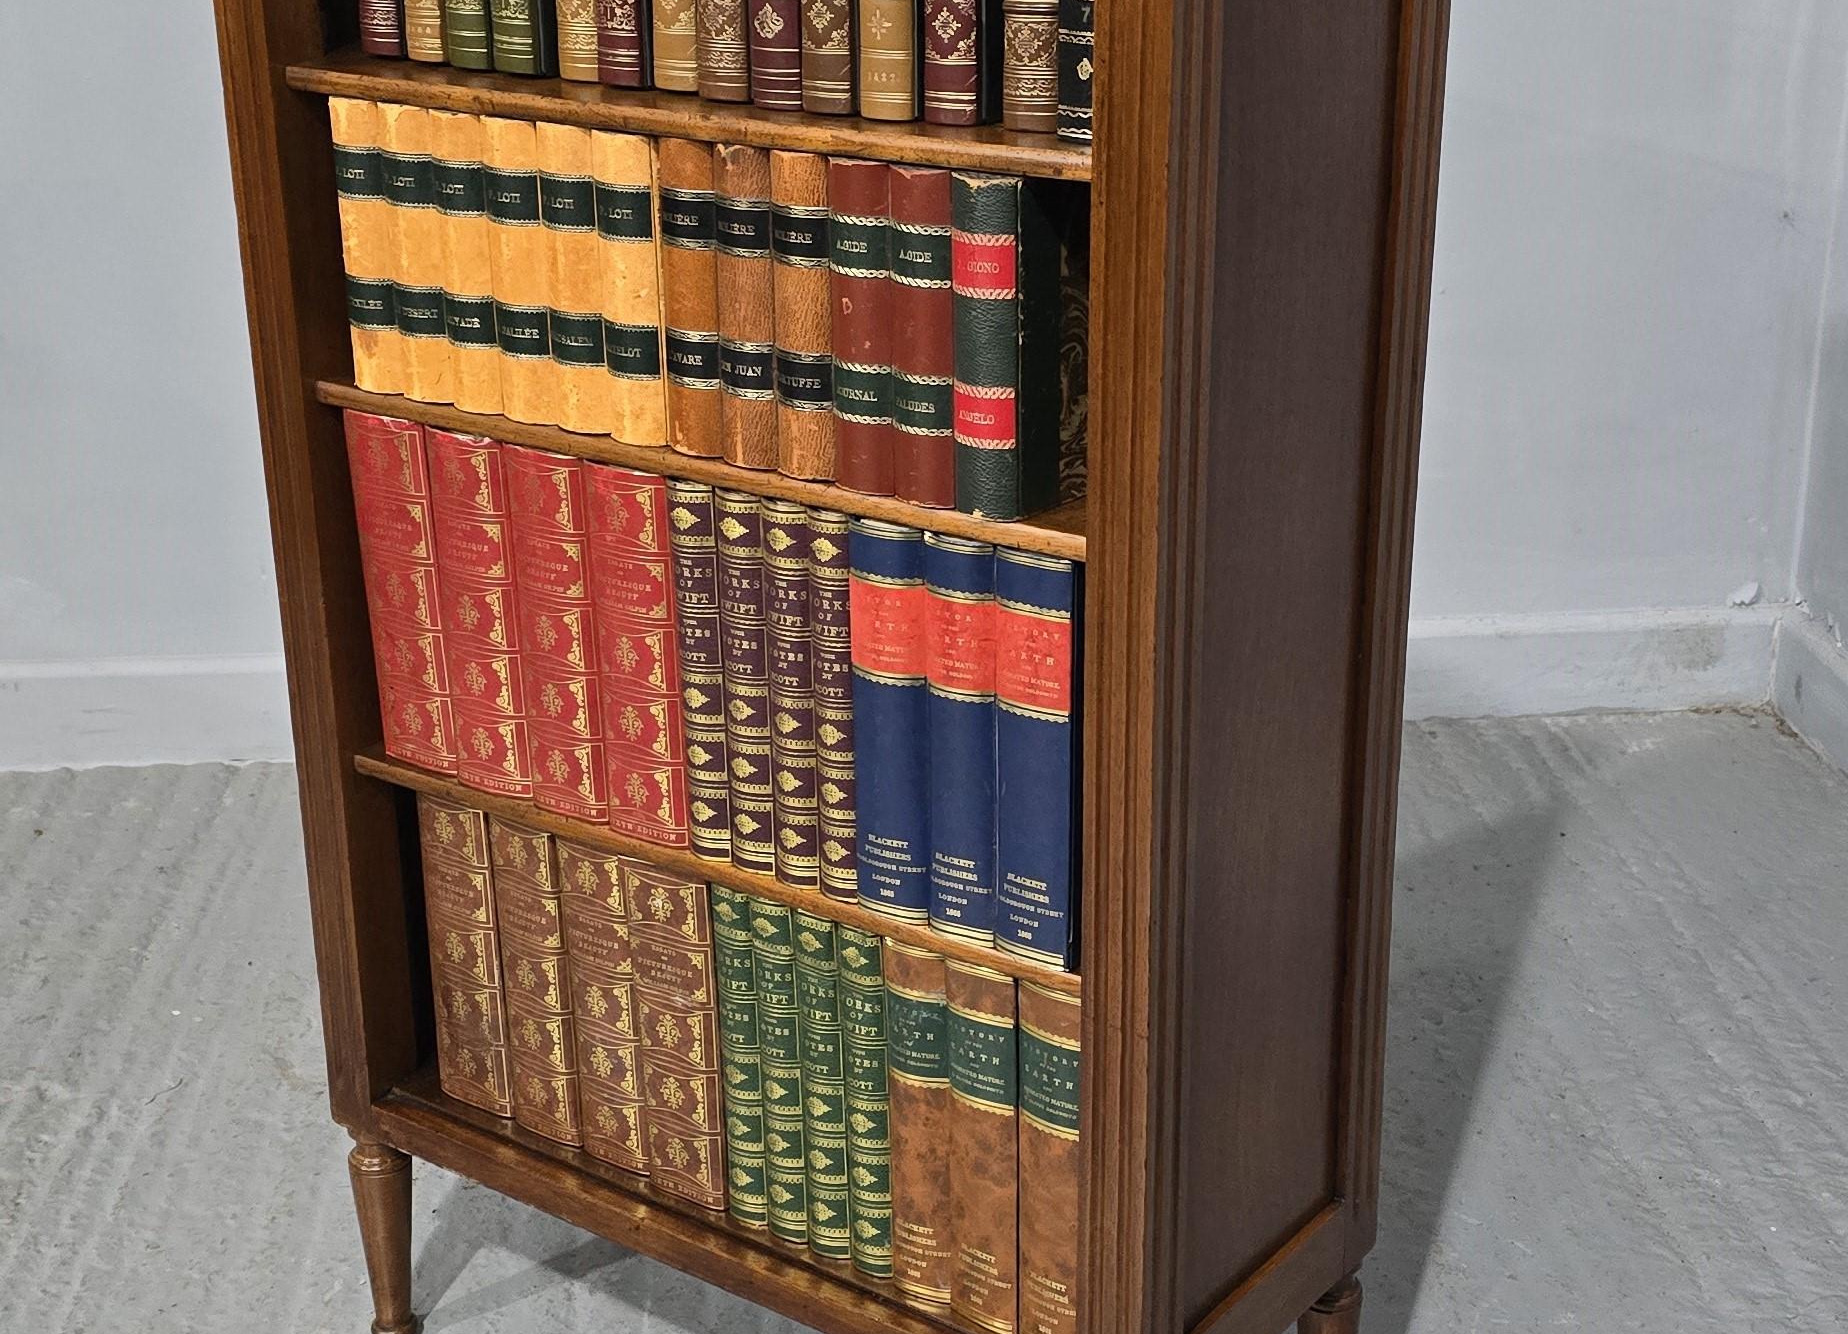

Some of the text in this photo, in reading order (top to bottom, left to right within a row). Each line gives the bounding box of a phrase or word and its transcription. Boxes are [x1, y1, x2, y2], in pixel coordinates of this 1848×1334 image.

[1081, 7, 1091, 23] 7
[676, 566, 713, 578] ORKS
[723, 575, 761, 589] ORKS
[679, 590, 710, 604] WIFT
[765, 584, 807, 600] ORKS
[722, 599, 757, 614] WIFT
[814, 597, 851, 611] ORKS
[768, 611, 804, 627] WIFT
[681, 626, 711, 638] OTES
[814, 623, 849, 637] WIFT
[725, 635, 758, 650] OTES
[681, 650, 707, 662] COTT
[772, 648, 804, 662] OTES
[725, 659, 753, 674] COTT
[814, 659, 849, 673] OTES
[771, 672, 800, 686] COTT
[816, 683, 845, 697] COTT
[484, 777, 523, 792] EDITION
[559, 801, 598, 818] EDITION
[636, 824, 678, 841] EDITION
[872, 873, 901, 886] LONDON
[938, 892, 968, 905] LONDON
[1010, 913, 1039, 927] LONDON
